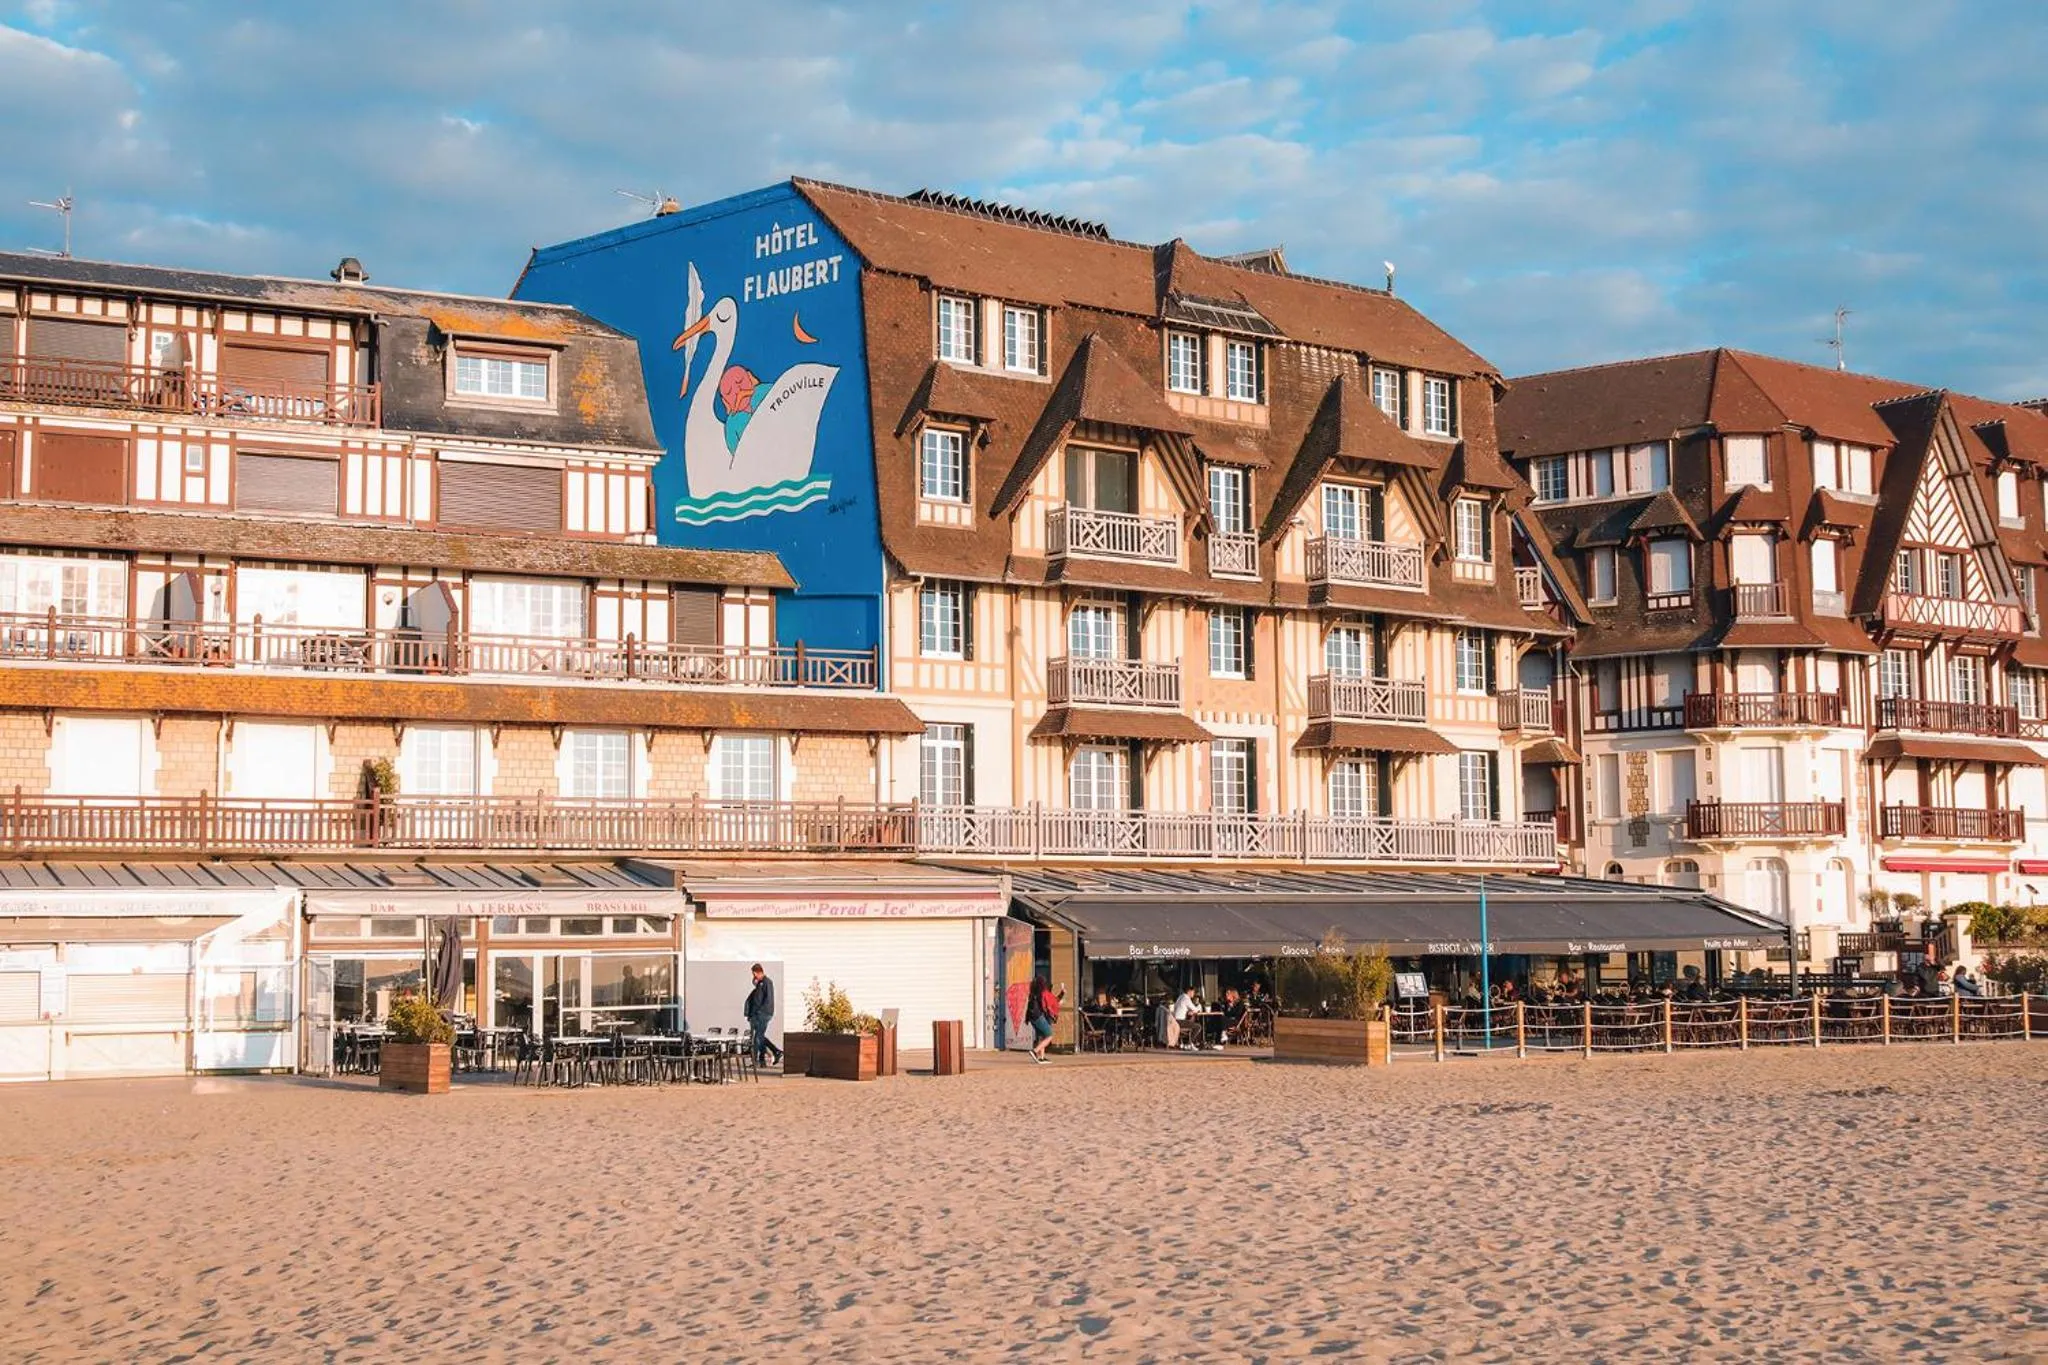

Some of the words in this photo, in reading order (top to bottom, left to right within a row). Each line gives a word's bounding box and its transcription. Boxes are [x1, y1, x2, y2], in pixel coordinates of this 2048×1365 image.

[755, 221, 819, 259] HÔTEL
[744, 254, 843, 303] FLAUBERT
[370, 903, 396, 913] BAR
[456, 903, 473, 914] LA
[1568, 942, 1581, 951] Bar
[1722, 939, 1732, 947] de
[1734, 938, 1749, 947] Mer
[1129, 945, 1144, 955] Bar
[1281, 946, 1309, 955] Glaces
[1428, 943, 1460, 953] BISTROT
